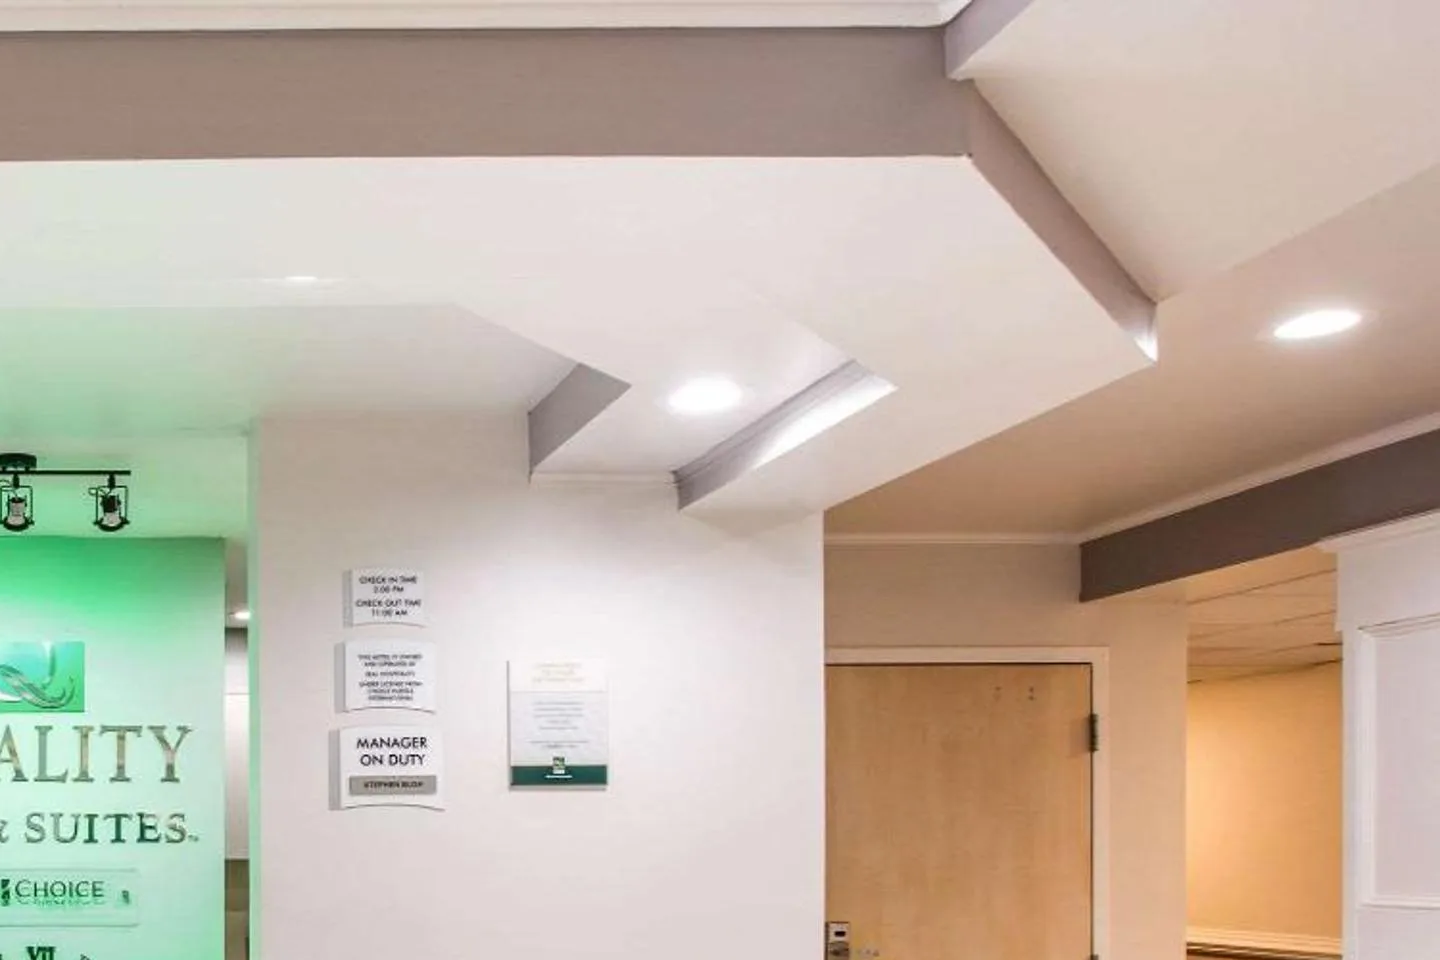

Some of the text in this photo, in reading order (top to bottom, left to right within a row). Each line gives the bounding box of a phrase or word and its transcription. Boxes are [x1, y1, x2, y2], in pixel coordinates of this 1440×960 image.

[358, 575, 417, 584] CHECK IN TIME
[392, 585, 404, 593] PM
[355, 598, 422, 607] CHECK OUT TIME
[356, 736, 428, 750] MANAGER
[360, 753, 426, 767] ON DUTY
[24, 811, 189, 844] SUITES
[14, 880, 106, 899] CHOICE
